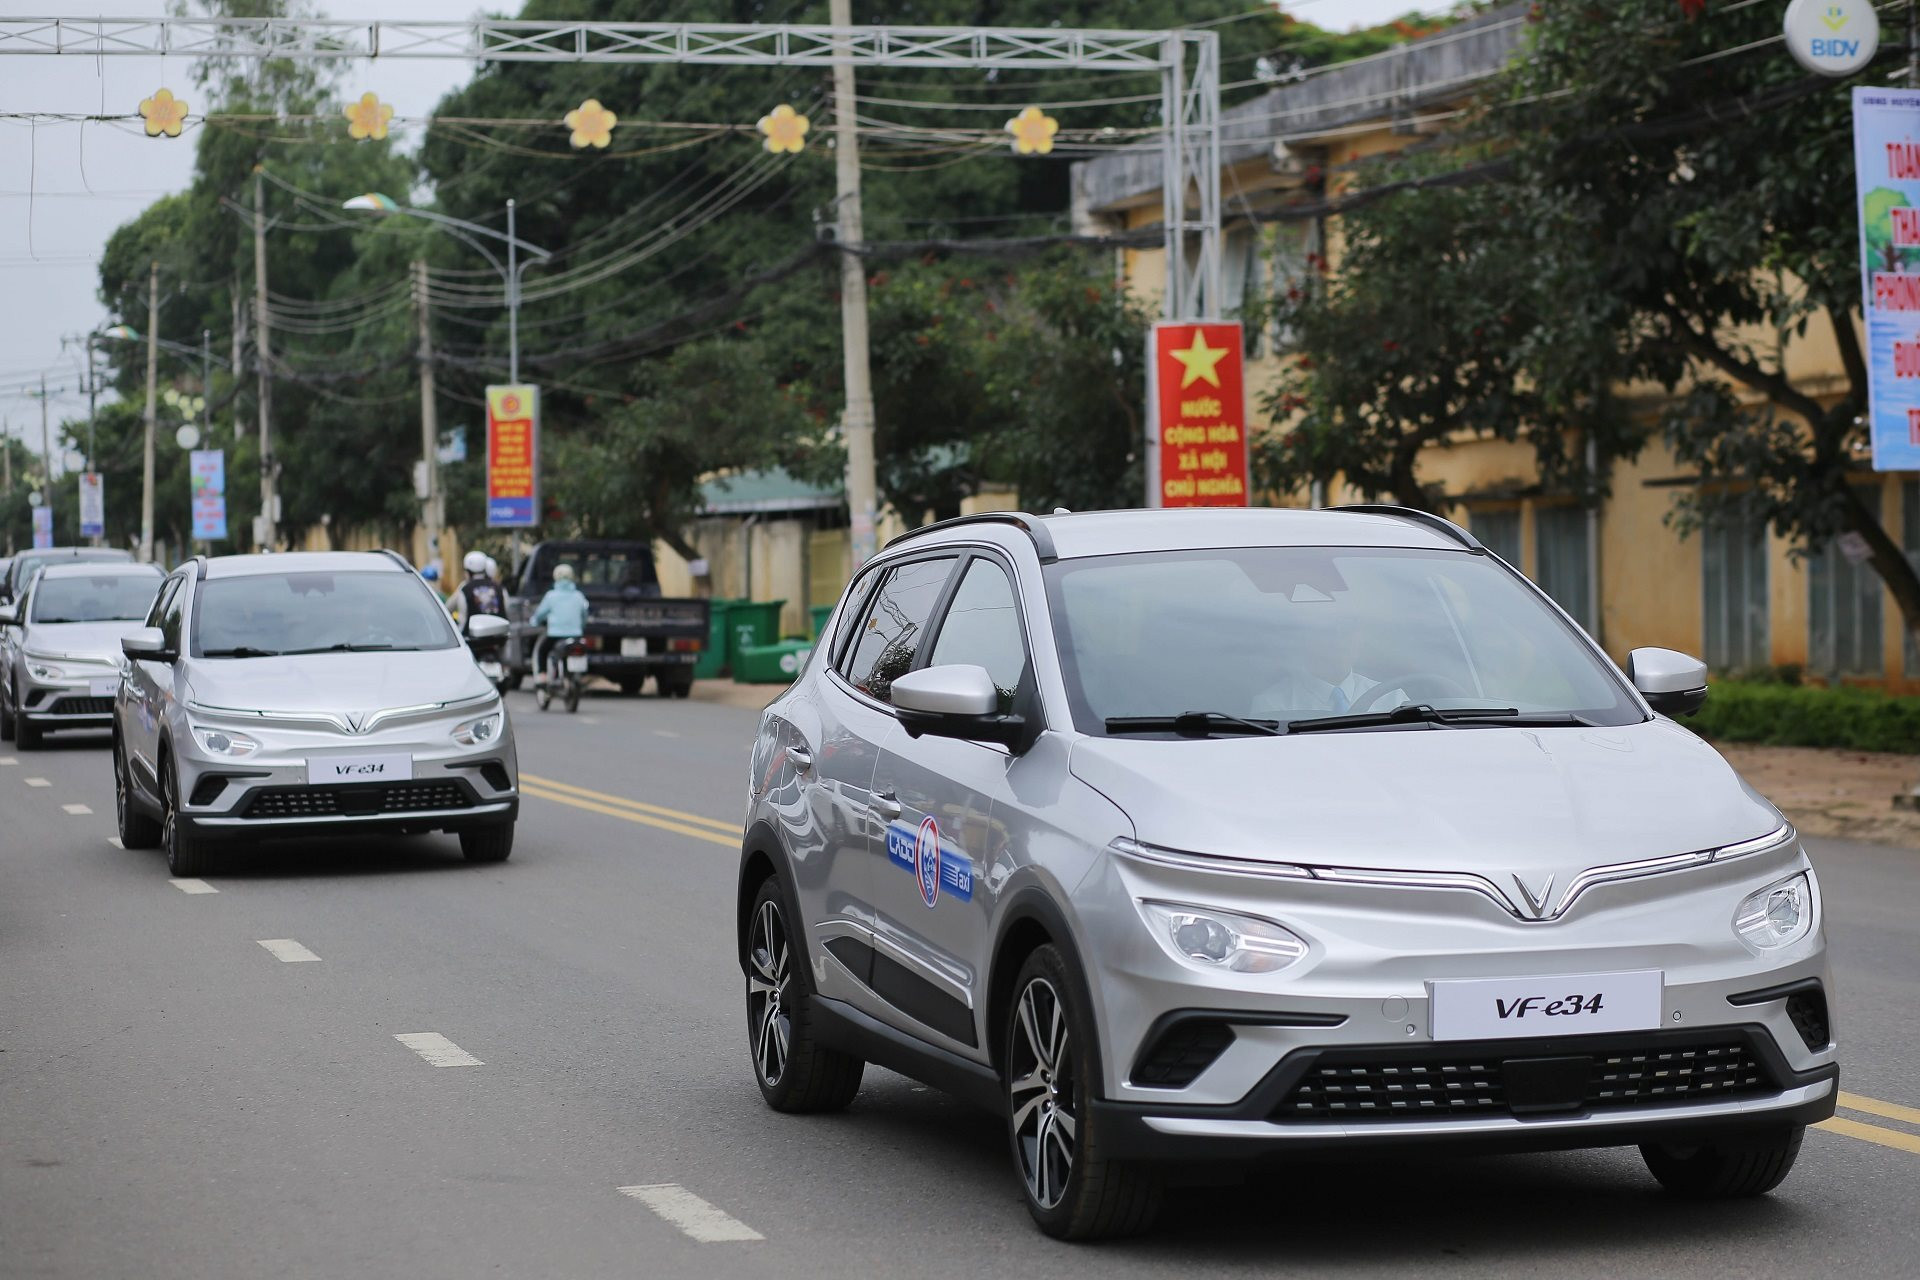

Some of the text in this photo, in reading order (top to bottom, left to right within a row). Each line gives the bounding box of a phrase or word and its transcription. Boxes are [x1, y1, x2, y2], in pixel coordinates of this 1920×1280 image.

[1811, 39, 1860, 57] BIDV
[889, 832, 915, 864] LADO
[943, 861, 970, 893] Taxi
